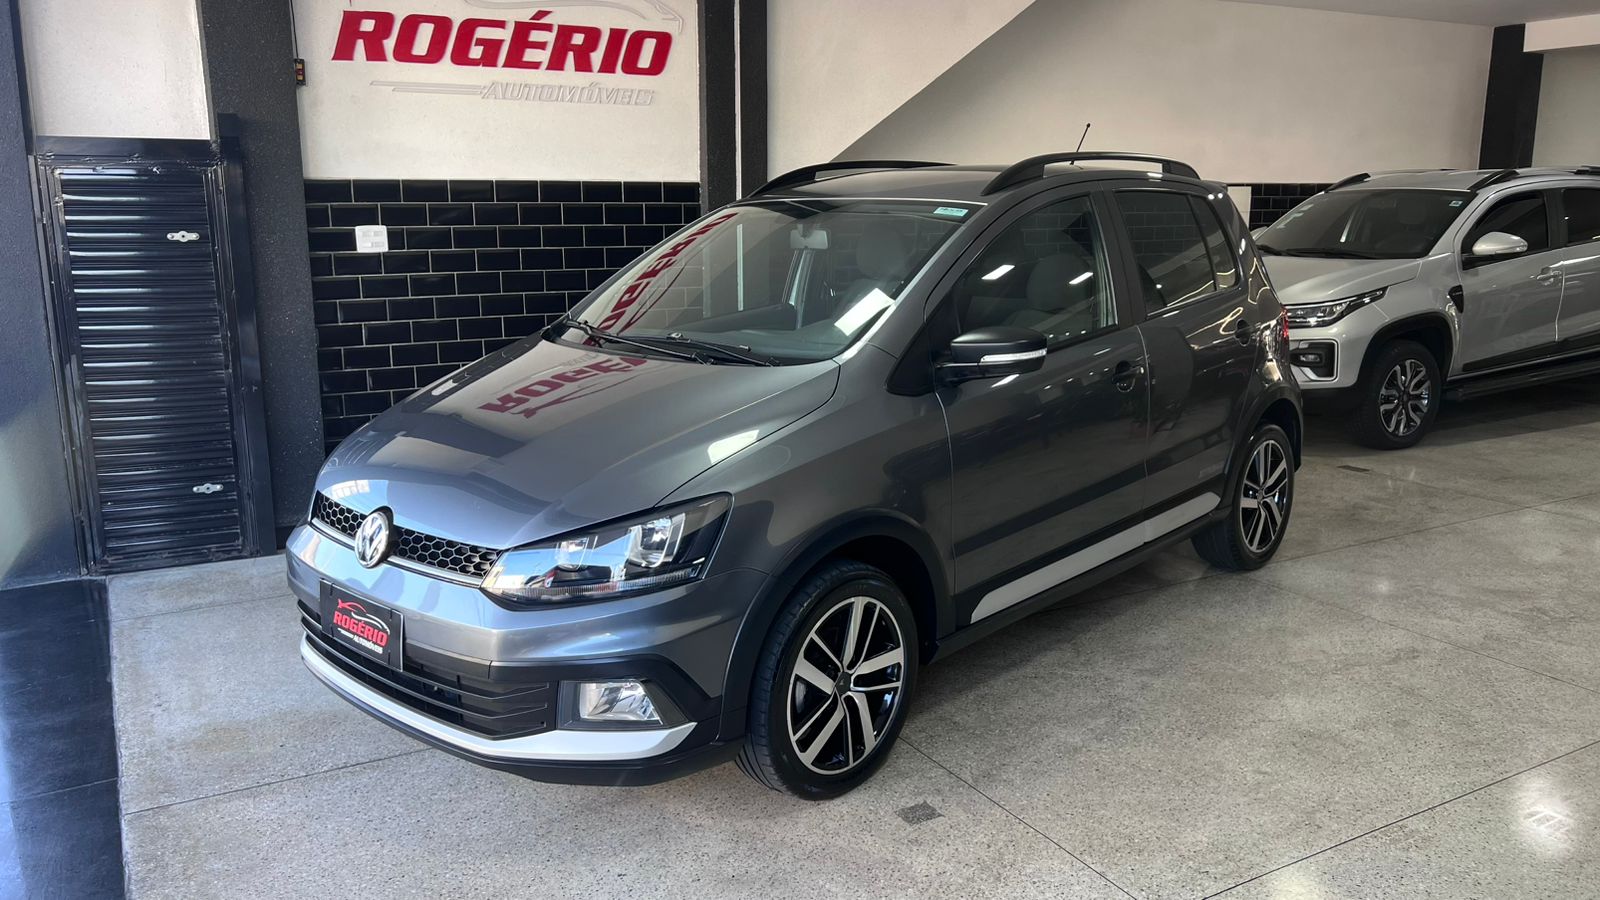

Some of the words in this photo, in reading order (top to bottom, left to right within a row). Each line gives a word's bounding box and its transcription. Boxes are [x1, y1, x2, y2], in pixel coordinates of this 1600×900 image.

[331, 10, 673, 76] ROGÉRIO
[481, 80, 655, 106] AUTOMÓVEIS
[333, 611, 388, 647] ROGÉRIO
